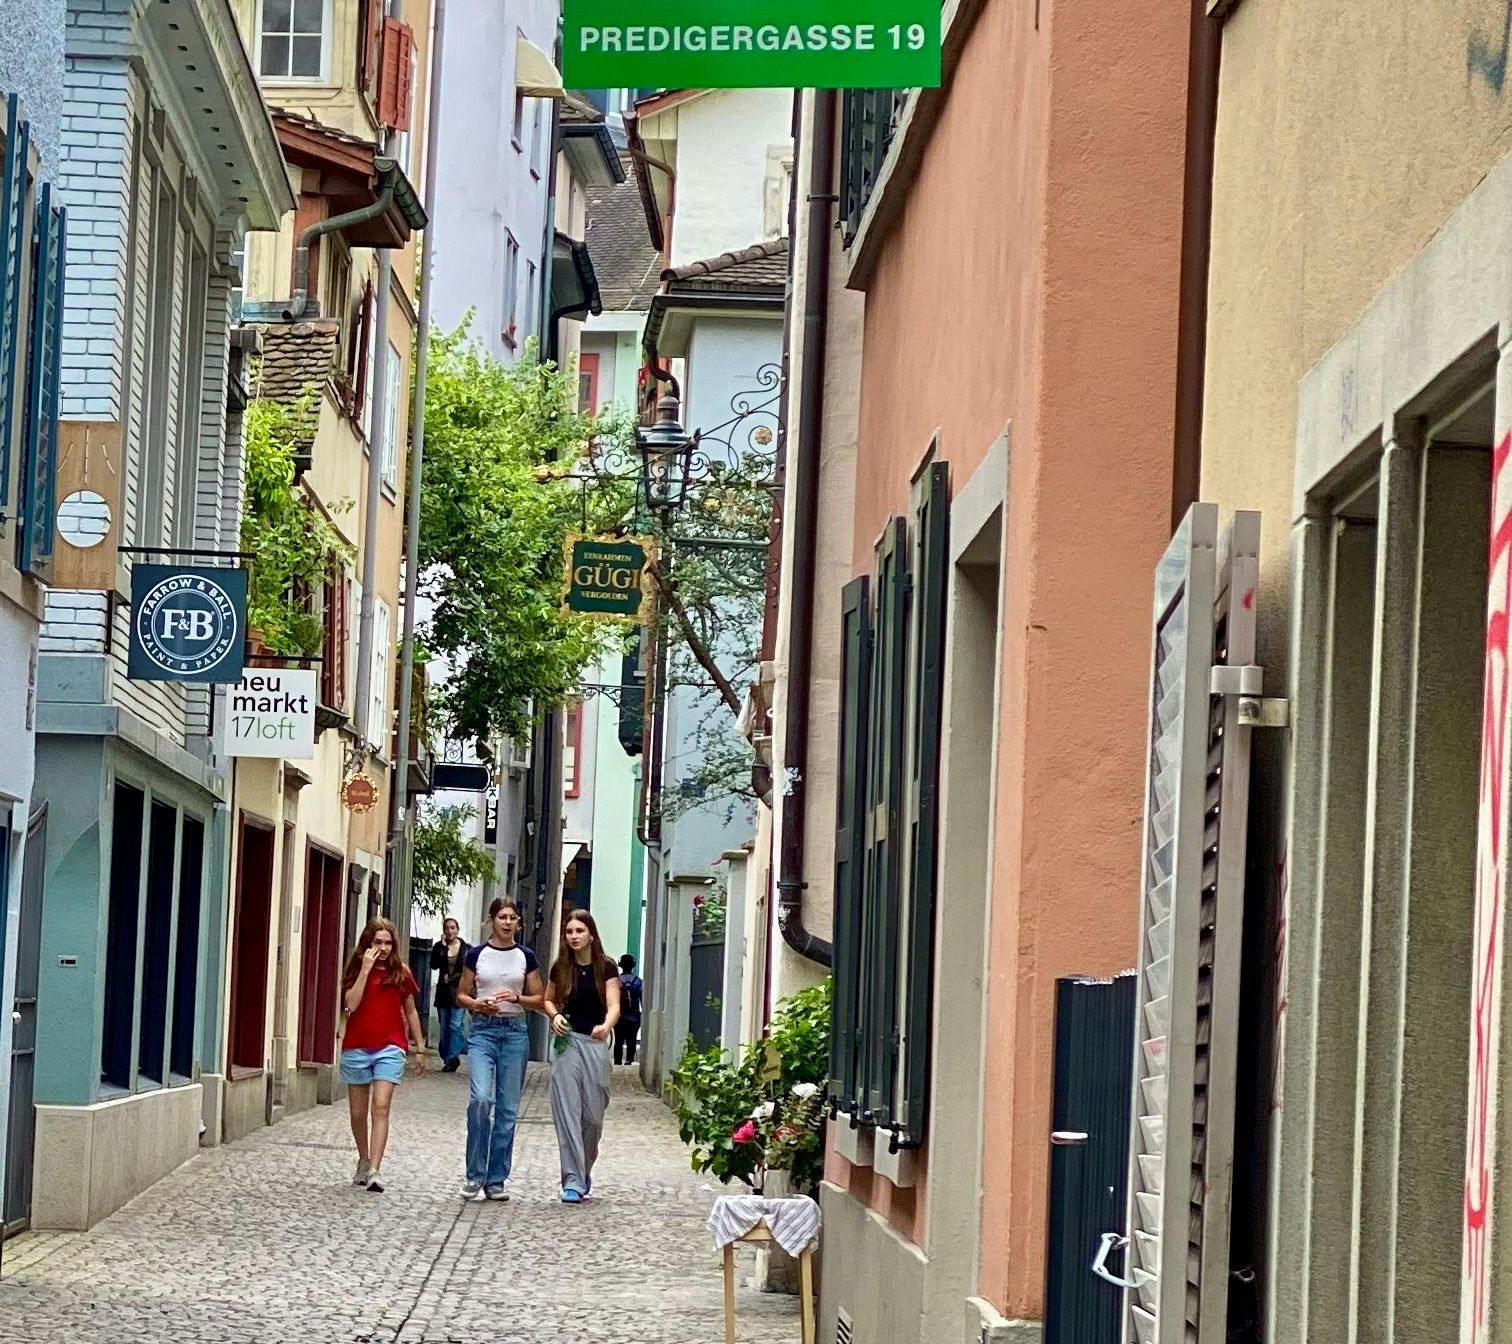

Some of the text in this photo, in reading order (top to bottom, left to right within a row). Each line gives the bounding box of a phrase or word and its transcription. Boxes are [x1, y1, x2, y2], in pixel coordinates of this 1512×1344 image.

[580, 23, 925, 52] PREDIGERGASSE 19
[573, 563, 640, 589] GÜGI
[144, 578, 232, 621] FARROW & BALL
[160, 608, 214, 641] F&B
[143, 633, 230, 670] PAINT & PAPER
[233, 692, 309, 714] markt
